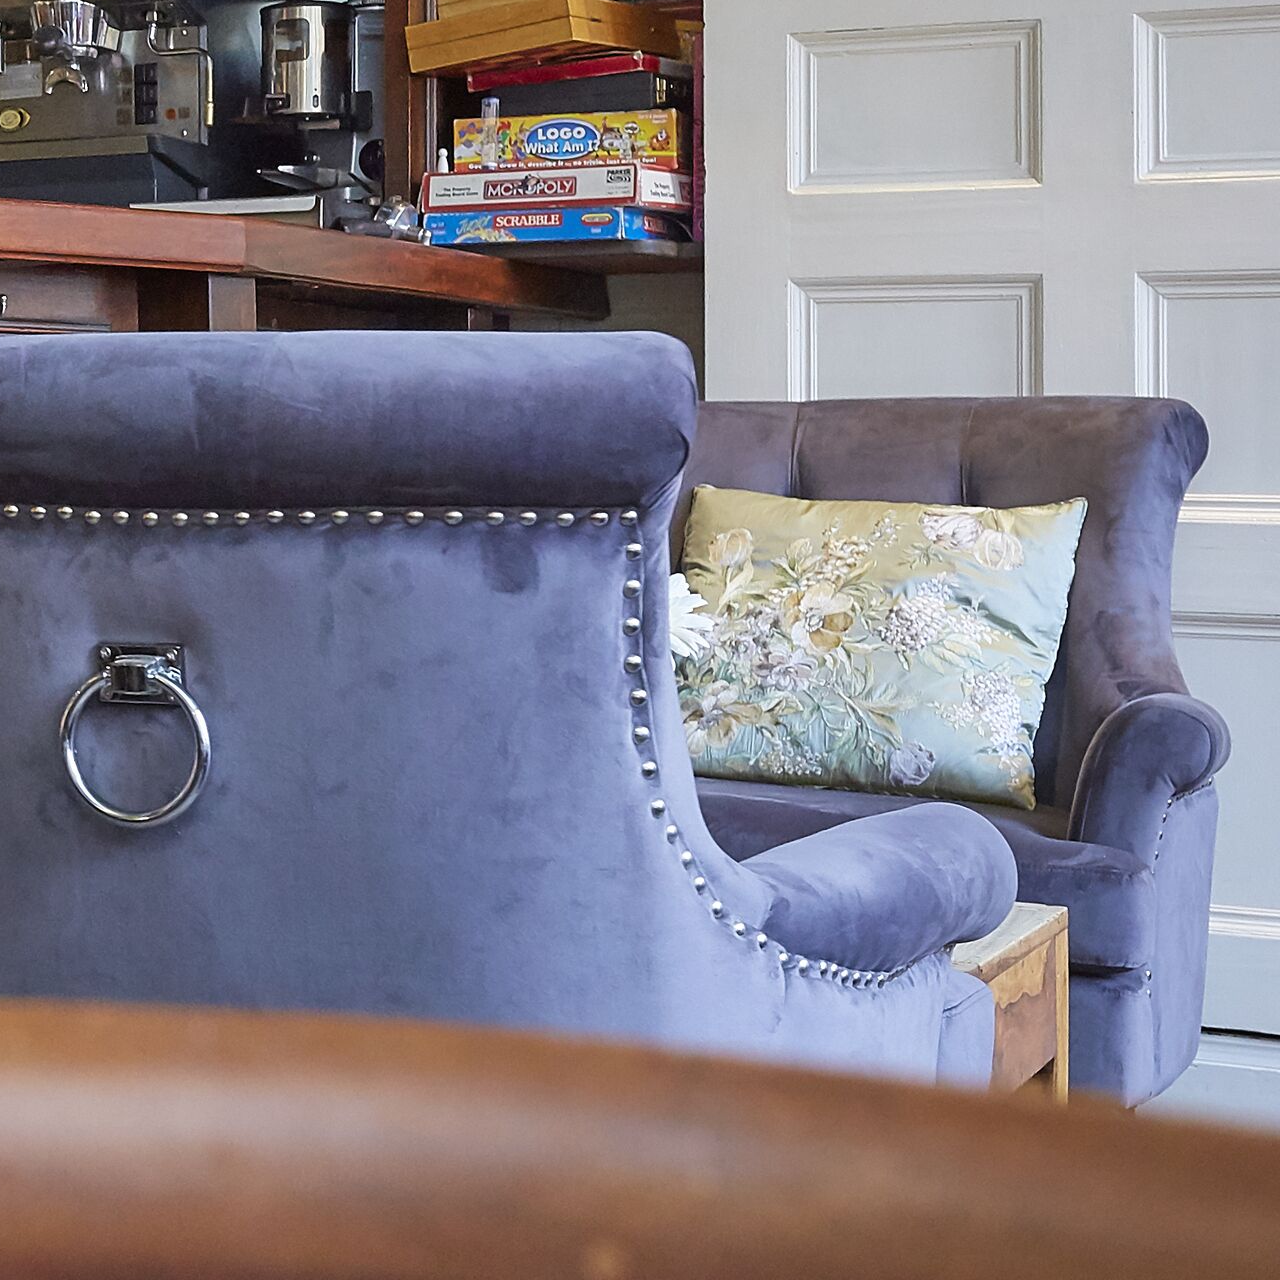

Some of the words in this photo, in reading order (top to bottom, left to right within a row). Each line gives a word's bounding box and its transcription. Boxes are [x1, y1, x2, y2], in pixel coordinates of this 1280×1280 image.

[537, 126, 586, 140] LOGO
[524, 140, 559, 154] What
[562, 140, 584, 152] Am
[587, 138, 600, 152] I?
[527, 160, 557, 168] describe
[641, 156, 657, 164] fun!
[487, 178, 573, 197] MONOPOLY
[495, 213, 560, 228] SCRABBLE
